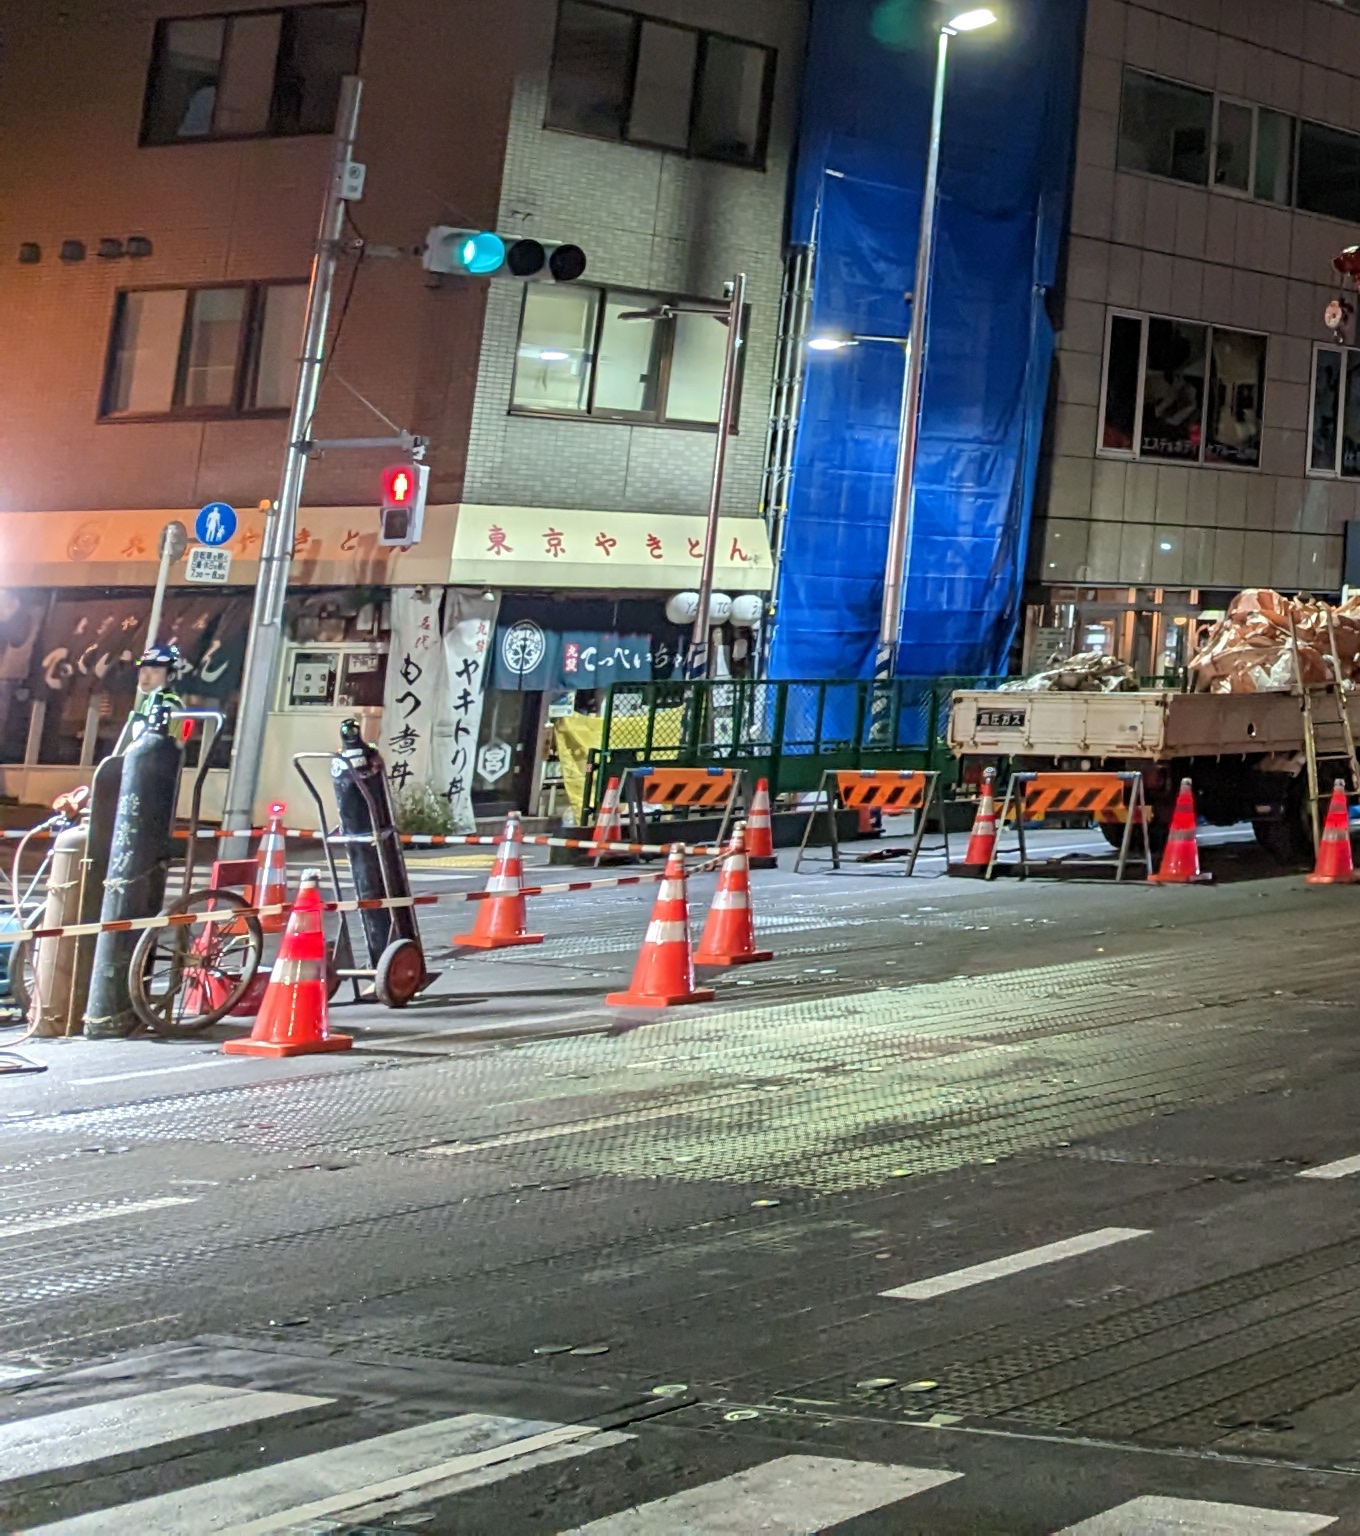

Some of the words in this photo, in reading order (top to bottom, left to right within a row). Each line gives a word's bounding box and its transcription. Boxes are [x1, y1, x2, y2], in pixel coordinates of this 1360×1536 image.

[486, 524, 749, 562] 東京やきとん
[388, 652, 422, 792] もつ煮丼
[441, 657, 480, 805] ヤキトリ丼
[980, 713, 1021, 725] 高圧ガス
